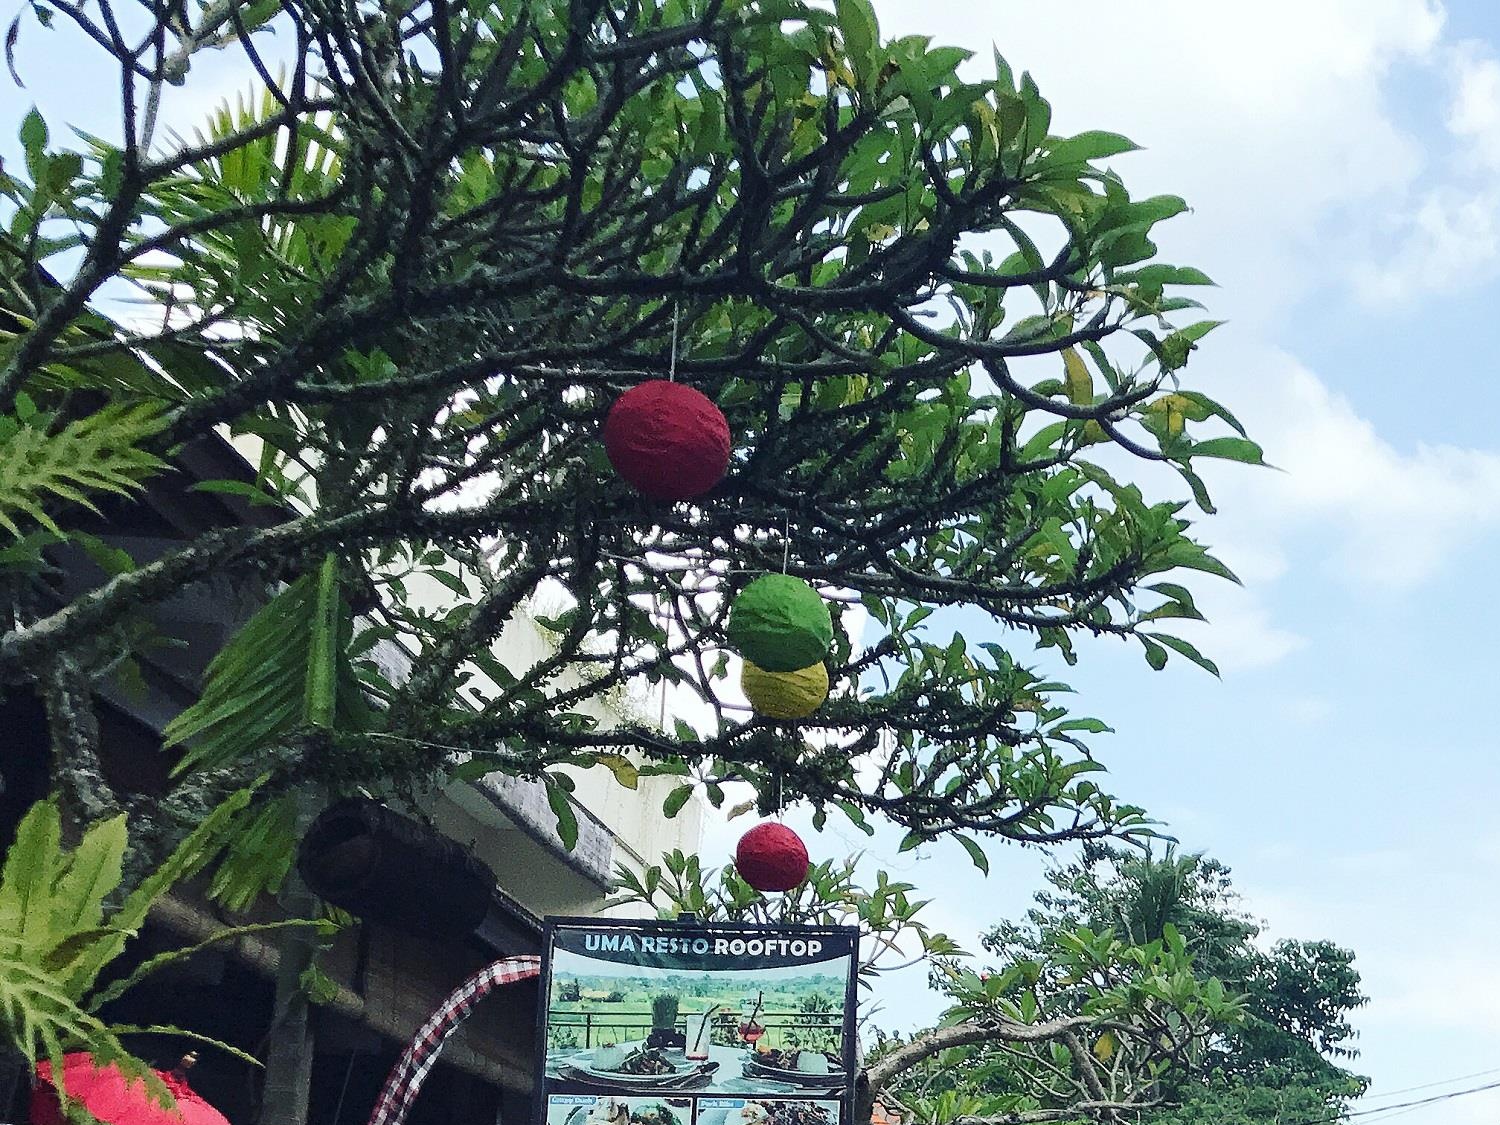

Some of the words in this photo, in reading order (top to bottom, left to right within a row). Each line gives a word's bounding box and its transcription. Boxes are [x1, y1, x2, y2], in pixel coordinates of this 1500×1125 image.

[585, 934, 635, 952] UMA
[641, 937, 709, 954] RESTO
[714, 938, 822, 957] ROOFTOP
